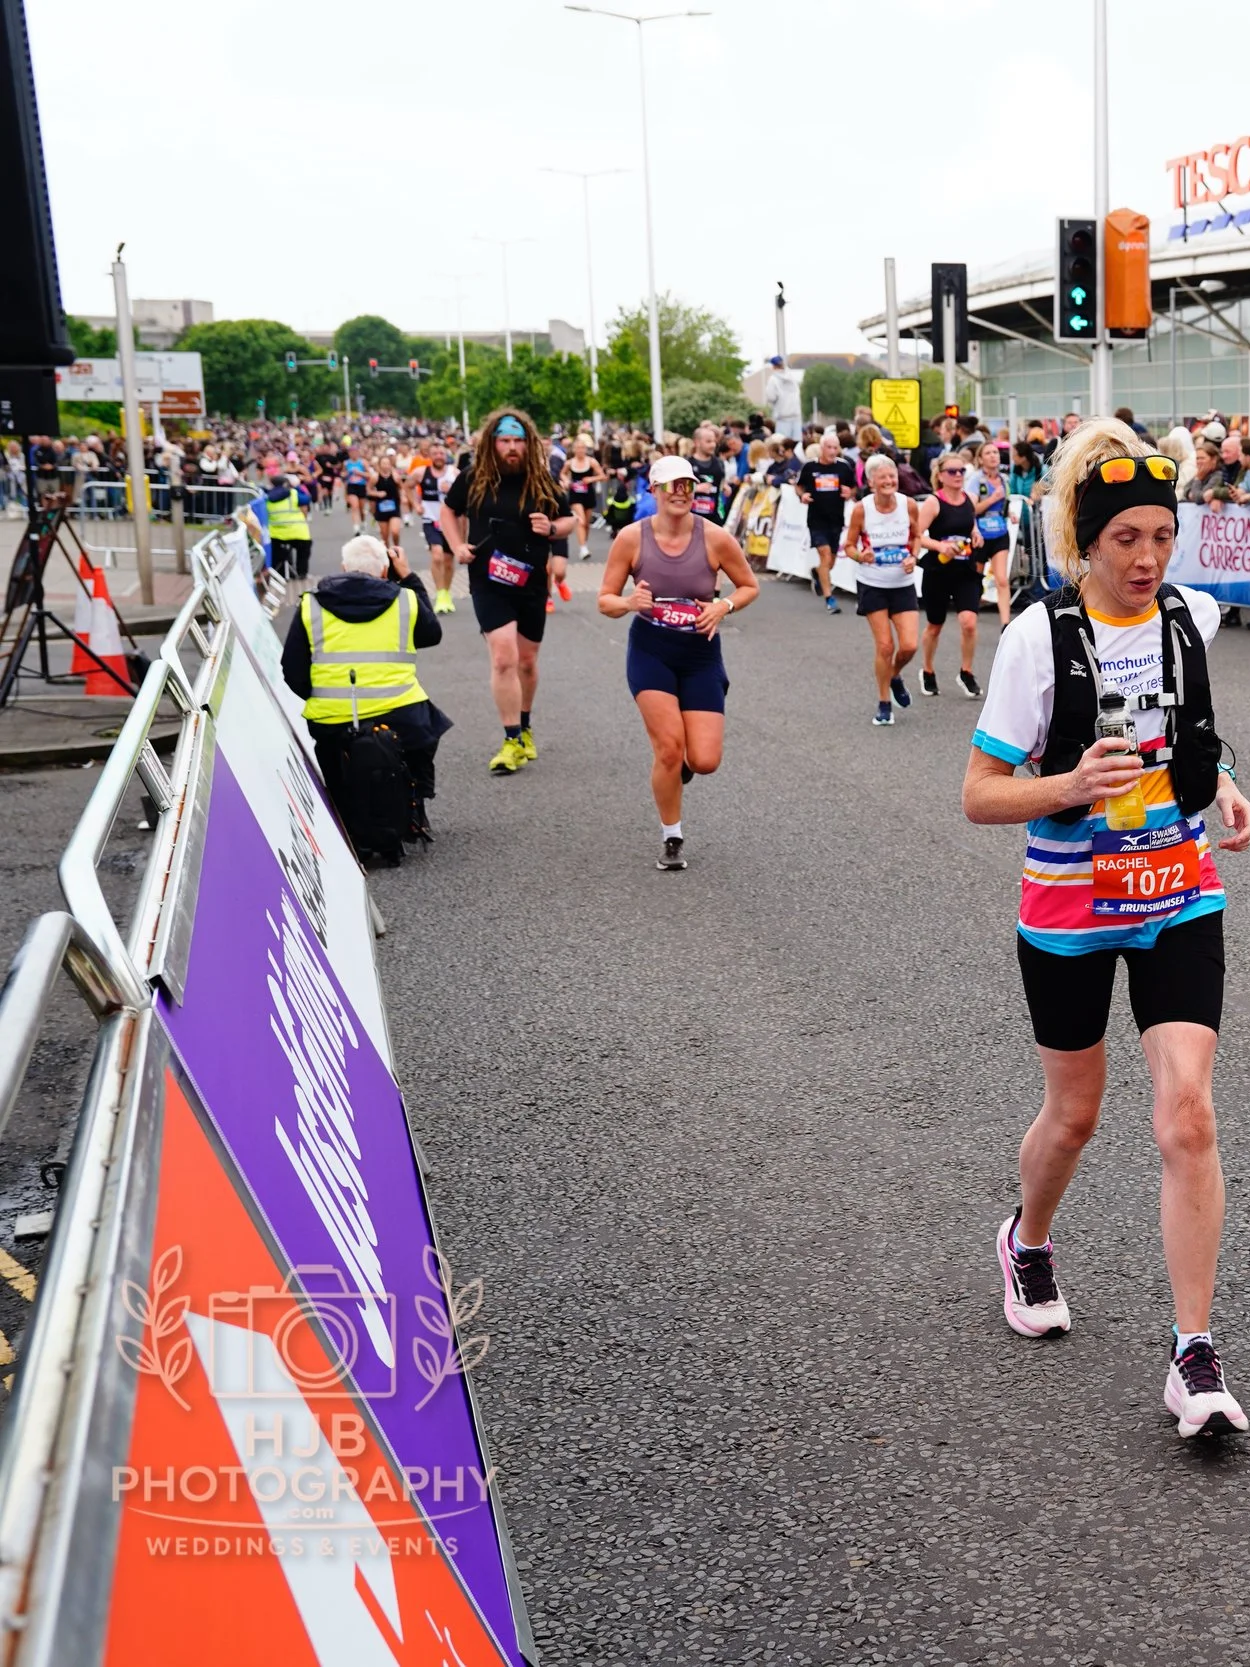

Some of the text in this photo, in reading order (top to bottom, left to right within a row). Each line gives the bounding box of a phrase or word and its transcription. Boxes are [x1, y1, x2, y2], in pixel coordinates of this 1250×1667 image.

[494, 564, 520, 583] 3326
[662, 609, 696, 625] 2579
[1151, 825, 1180, 839] SWANSEA
[1097, 857, 1152, 871] RACHEL
[1121, 863, 1185, 896] 1072
[1119, 895, 1185, 913] #RUNSWANSEA
